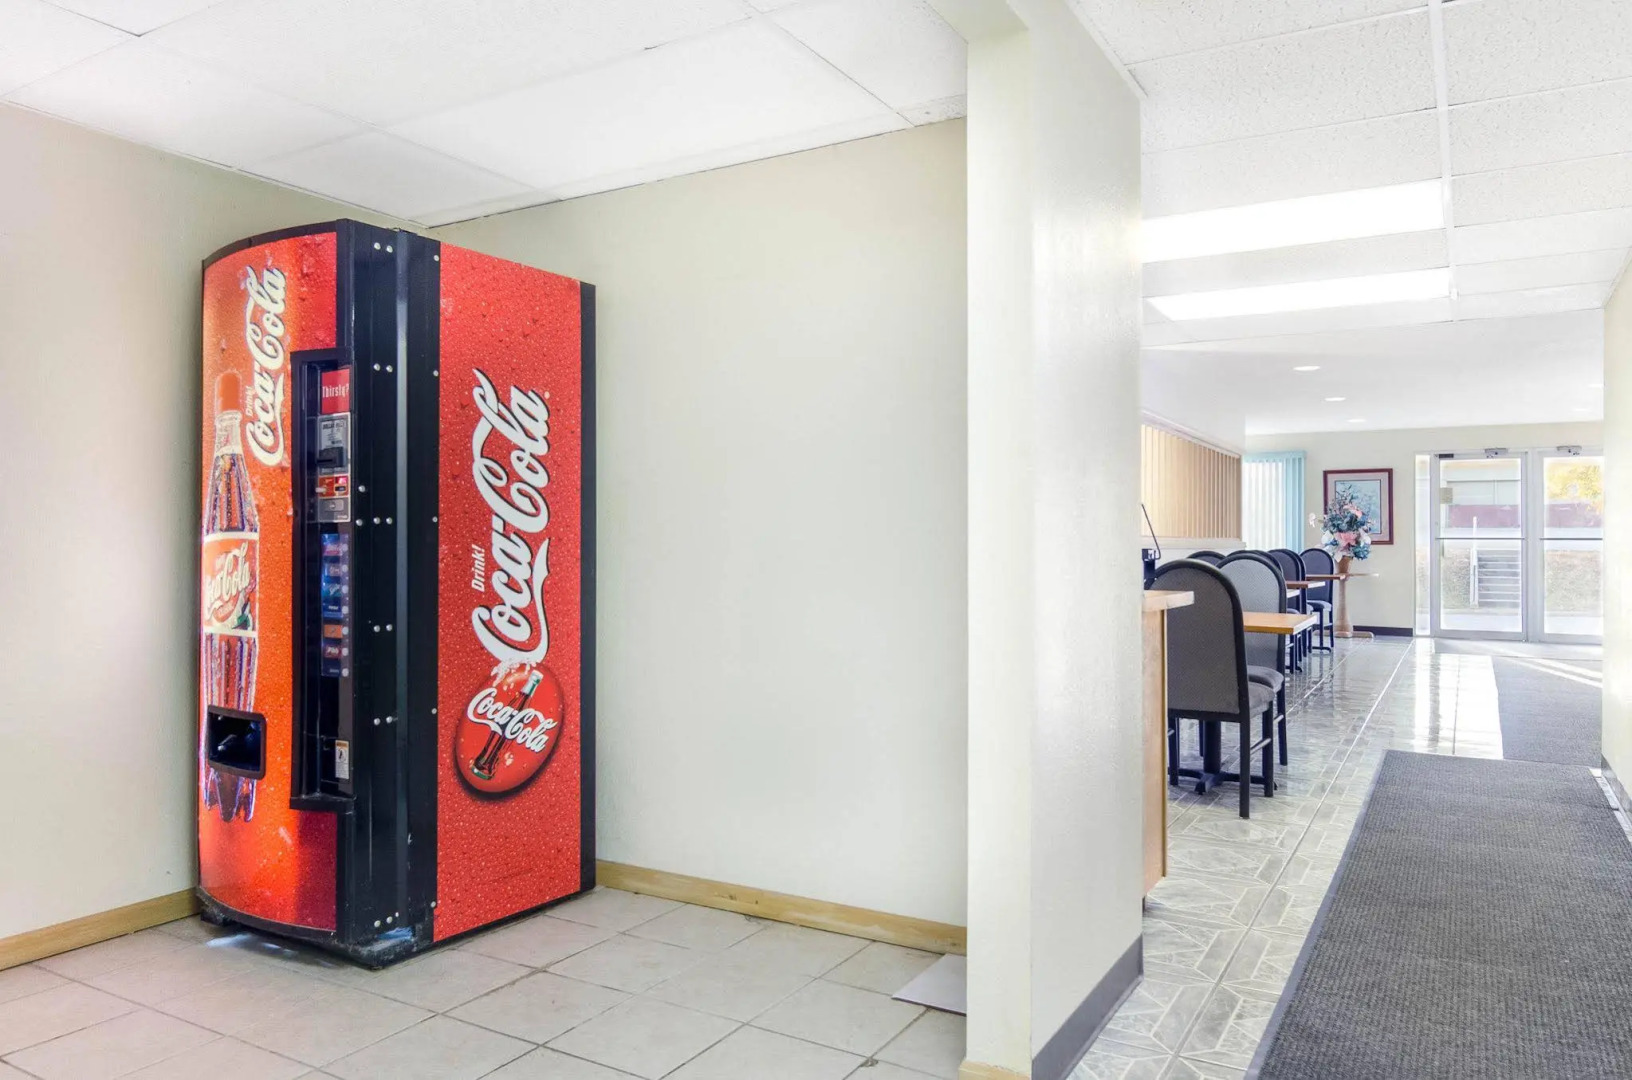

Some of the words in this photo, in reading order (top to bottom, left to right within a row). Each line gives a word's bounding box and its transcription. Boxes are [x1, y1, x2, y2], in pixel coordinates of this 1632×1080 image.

[244, 265, 286, 466] Coca-Cola
[471, 545, 486, 592] Drink!
[472, 367, 548, 664] Coca-Cola
[467, 687, 558, 753] Coca-Cola
